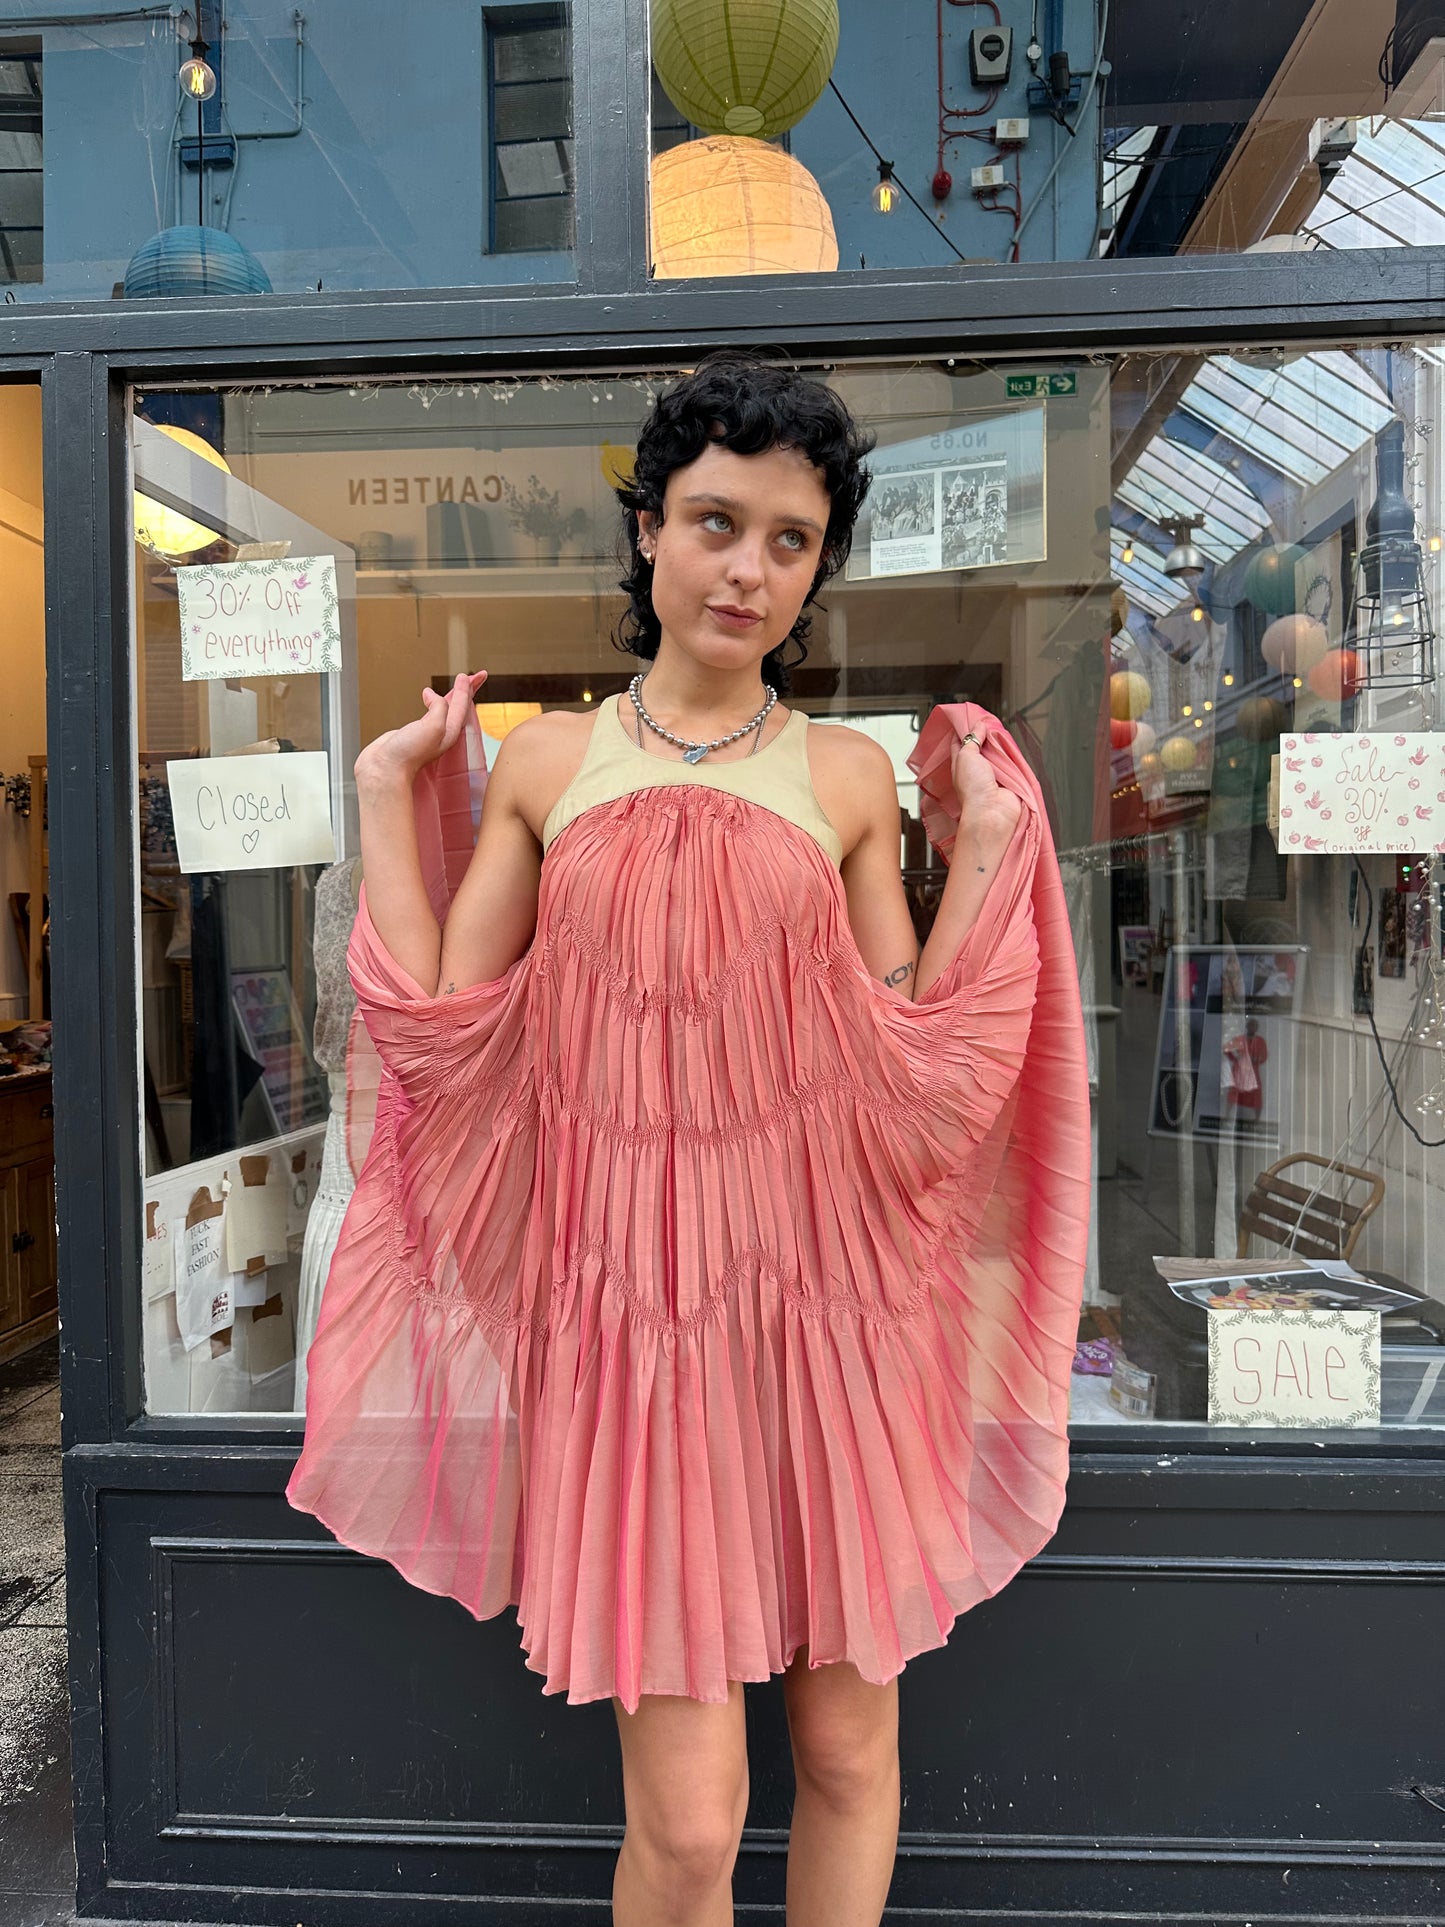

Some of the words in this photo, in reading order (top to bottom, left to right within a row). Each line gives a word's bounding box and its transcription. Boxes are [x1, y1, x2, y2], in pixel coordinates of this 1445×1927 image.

[195, 578, 251, 619] 30%
[265, 578, 302, 617] Off
[205, 628, 313, 666] everything
[1335, 745, 1406, 784] Sale
[197, 783, 291, 831] Closed
[1344, 787, 1389, 824] 30%
[1353, 825, 1372, 842] off
[186, 1247, 220, 1277] FASHION
[191, 1236, 210, 1257] FAST
